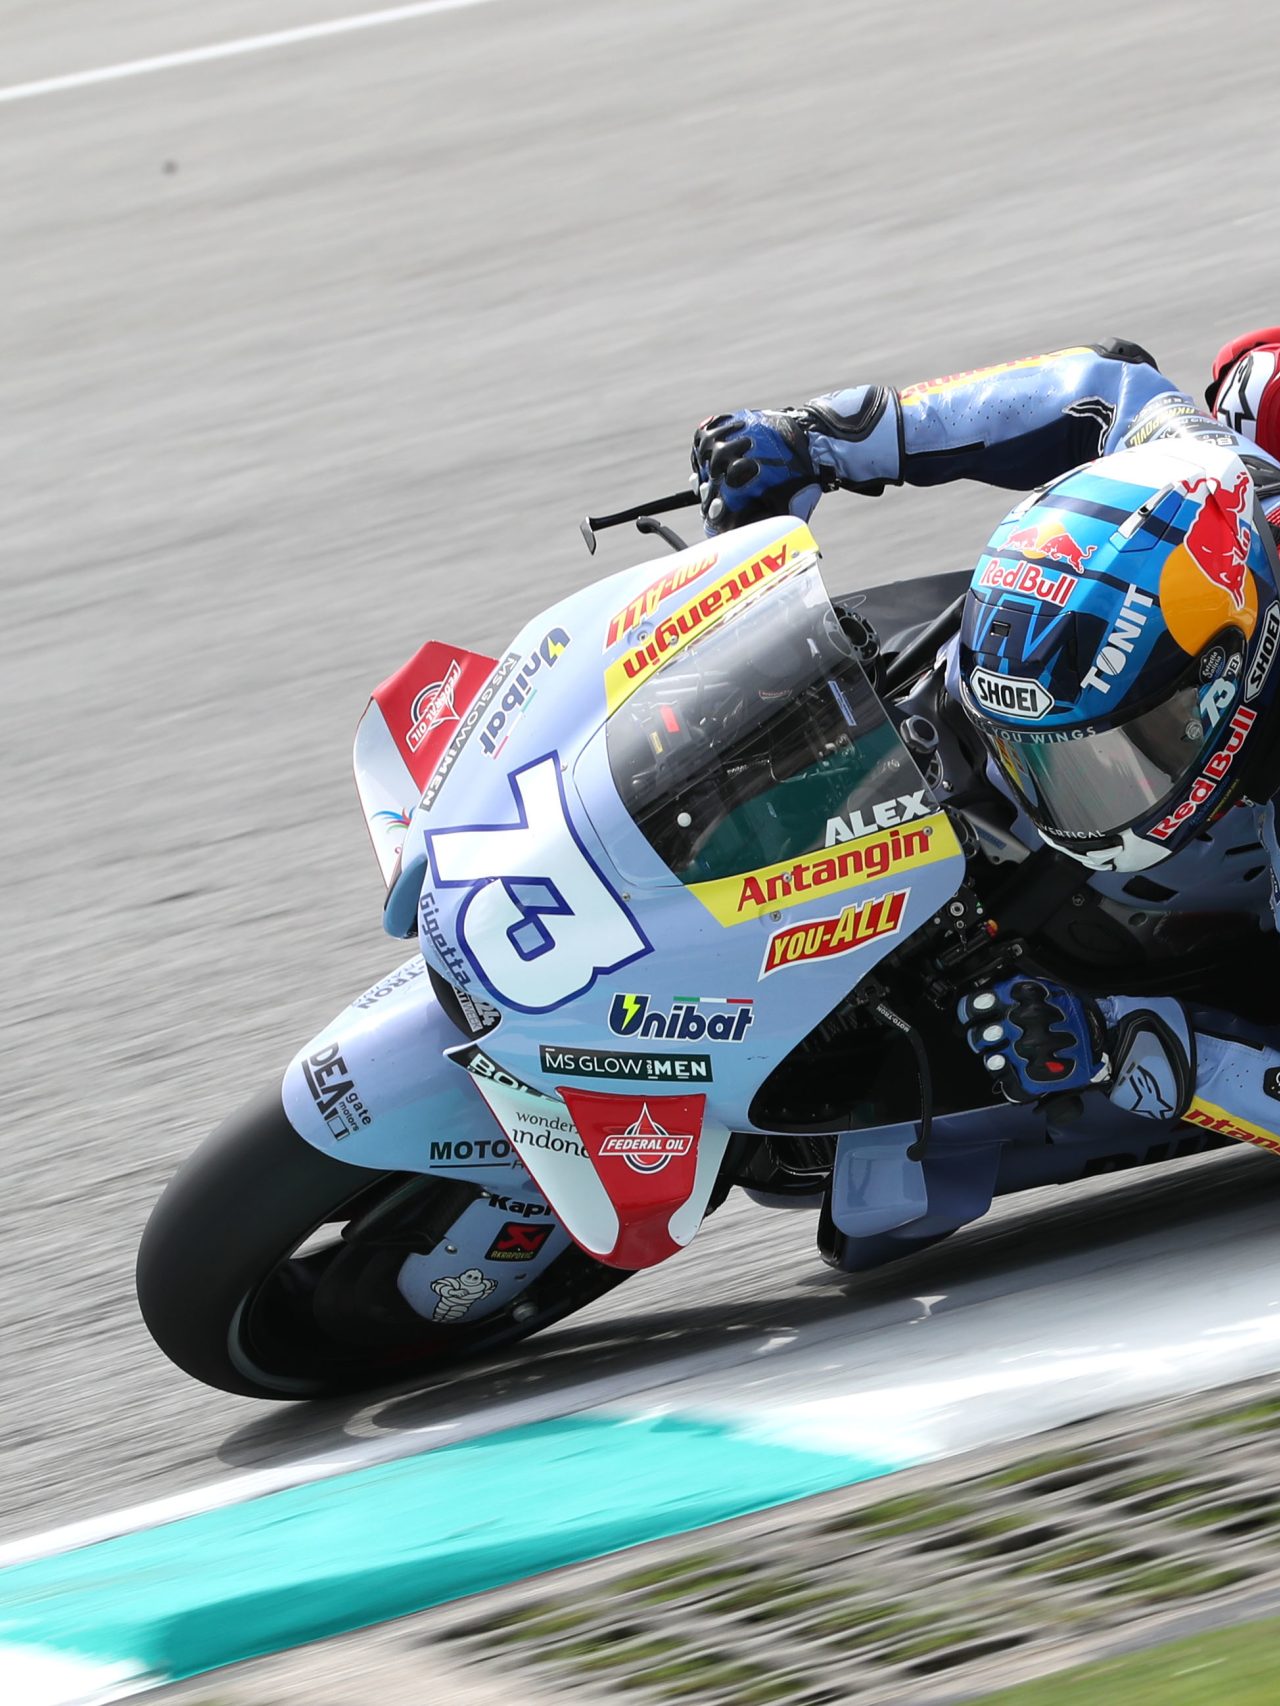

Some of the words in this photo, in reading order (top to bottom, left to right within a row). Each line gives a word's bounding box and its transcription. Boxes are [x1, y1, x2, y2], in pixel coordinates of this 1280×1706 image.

[980, 559, 1027, 588] Red
[1019, 563, 1076, 606] Bull
[623, 544, 787, 679] Antangin
[1250, 616, 1280, 689] SHOEI
[480, 627, 571, 756] Unibat
[978, 677, 1039, 713] SHOEI
[1200, 677, 1235, 728] 73
[1030, 726, 1098, 744] WINGS
[1147, 777, 1216, 840] Red
[1203, 705, 1257, 780] Bull
[824, 789, 931, 848] ALEX
[737, 829, 930, 912] Antangin
[419, 892, 473, 992] Gigetta
[772, 892, 896, 966] YOU-ALL
[608, 993, 754, 1042] Unibat
[307, 1042, 355, 1115] DEA
[545, 1052, 575, 1070] MS
[578, 1056, 643, 1075] GLOW
[654, 1060, 707, 1076] MEN
[338, 1101, 360, 1132] motors
[345, 1092, 372, 1126] gate
[515, 1111, 580, 1135] wonder
[606, 1138, 663, 1151] FEDERAL
[665, 1139, 685, 1151] OIL
